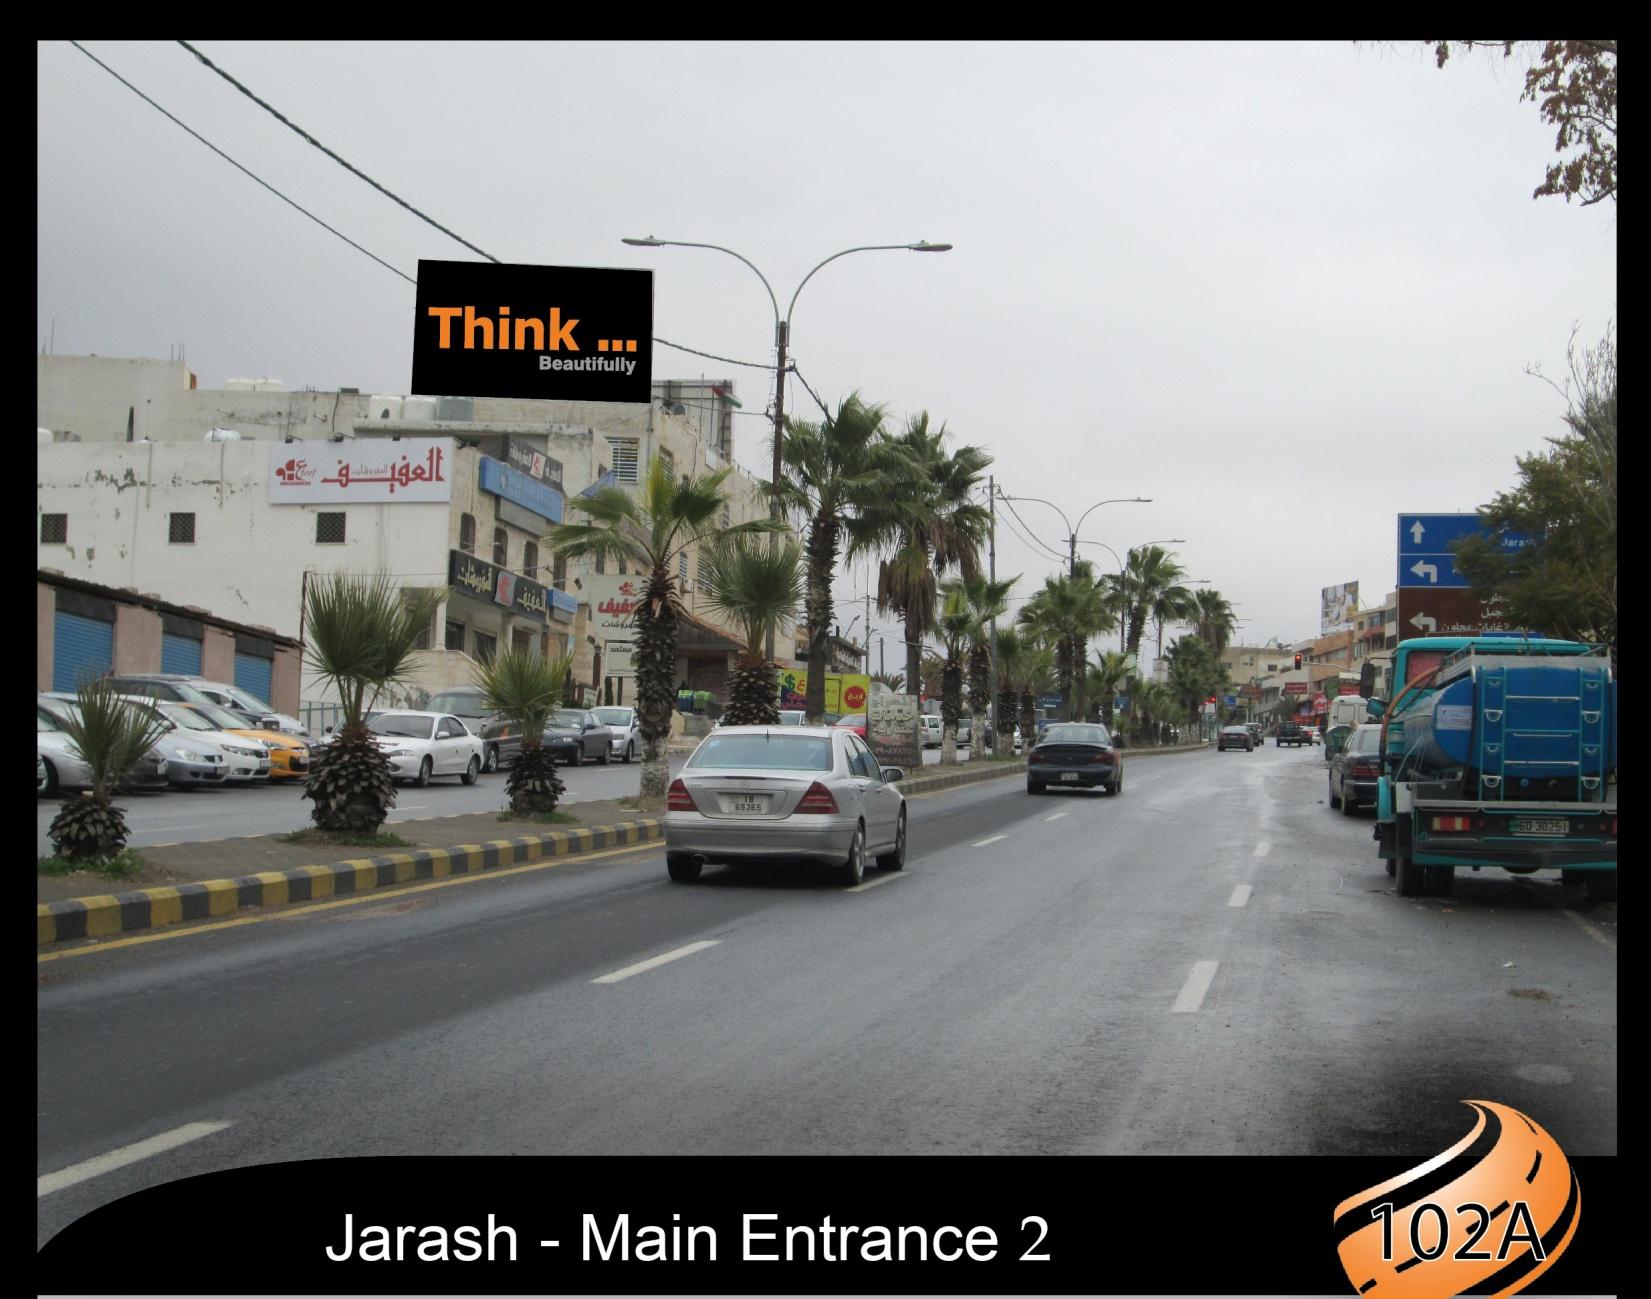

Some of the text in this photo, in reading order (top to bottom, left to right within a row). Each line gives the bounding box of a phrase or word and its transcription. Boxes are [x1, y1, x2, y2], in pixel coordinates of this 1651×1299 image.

[428, 306, 580, 351] Think
[539, 355, 637, 376] Beautifully
[320, 446, 445, 494] العفيف
